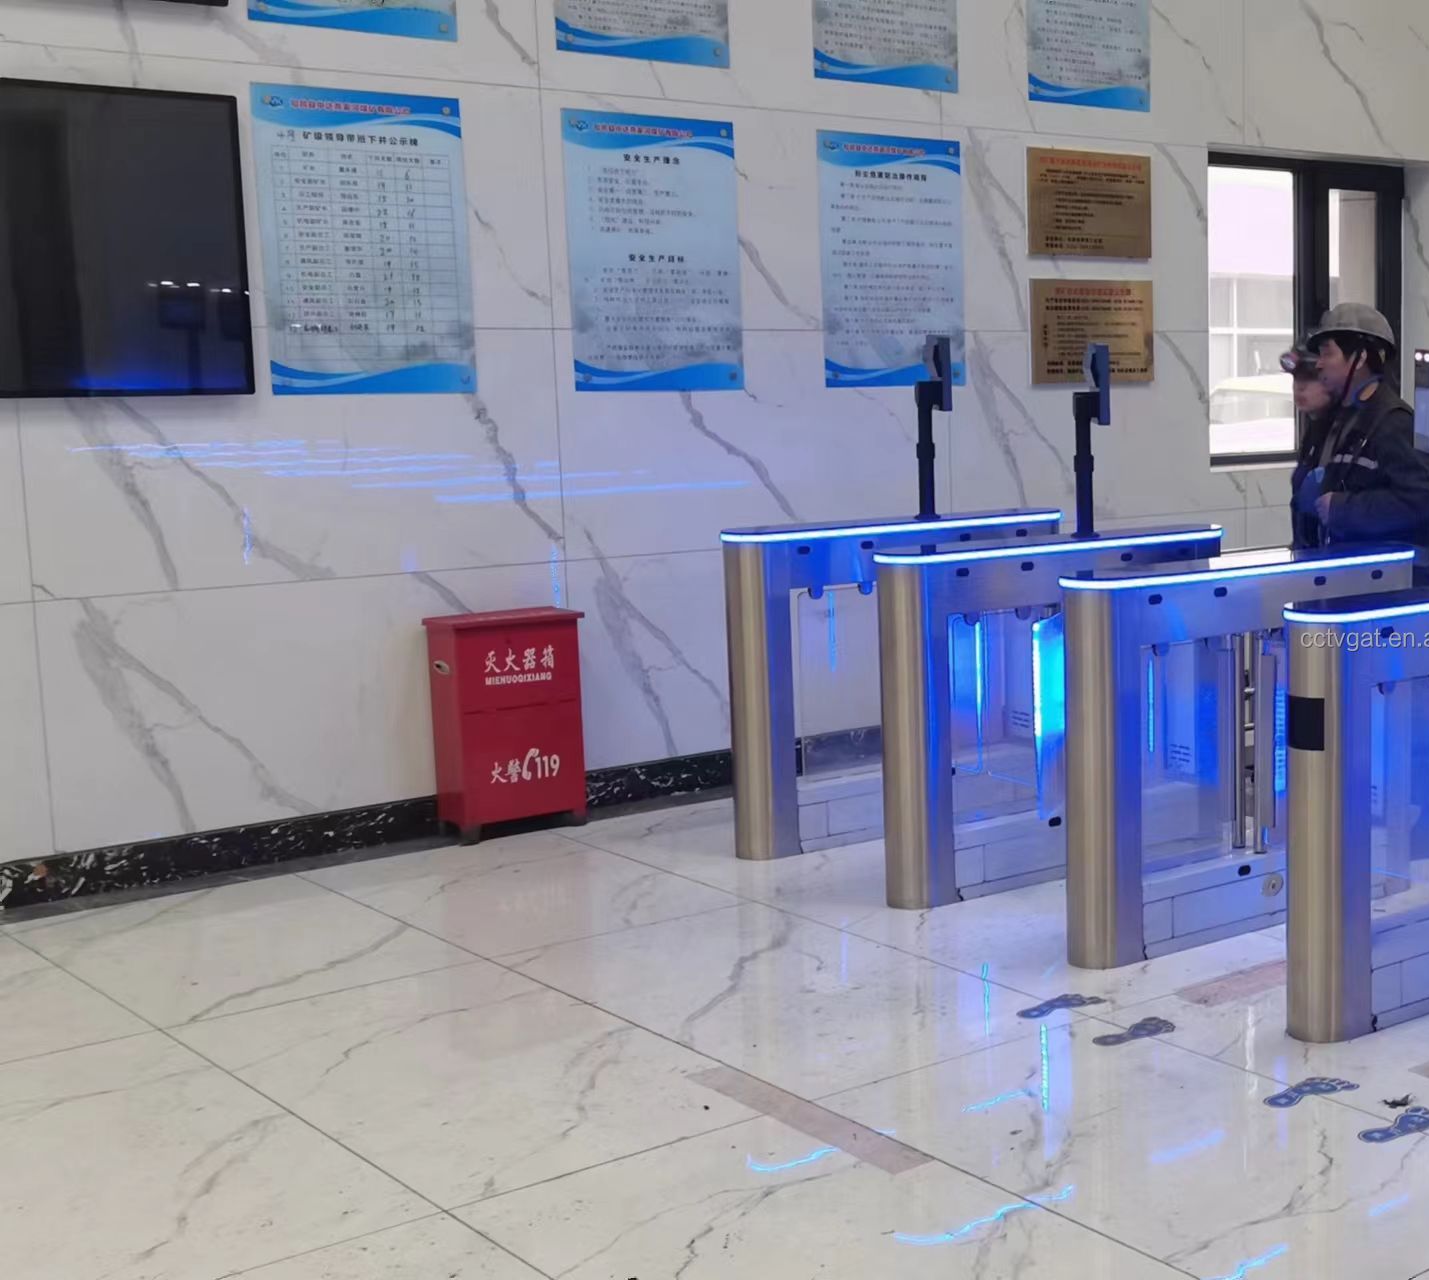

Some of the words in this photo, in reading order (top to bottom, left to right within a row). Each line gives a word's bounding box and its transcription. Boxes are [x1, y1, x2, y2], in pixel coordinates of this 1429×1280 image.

[485, 645, 554, 673] 灭火器箱
[490, 758, 521, 784] 火警
[535, 754, 560, 779] 119
